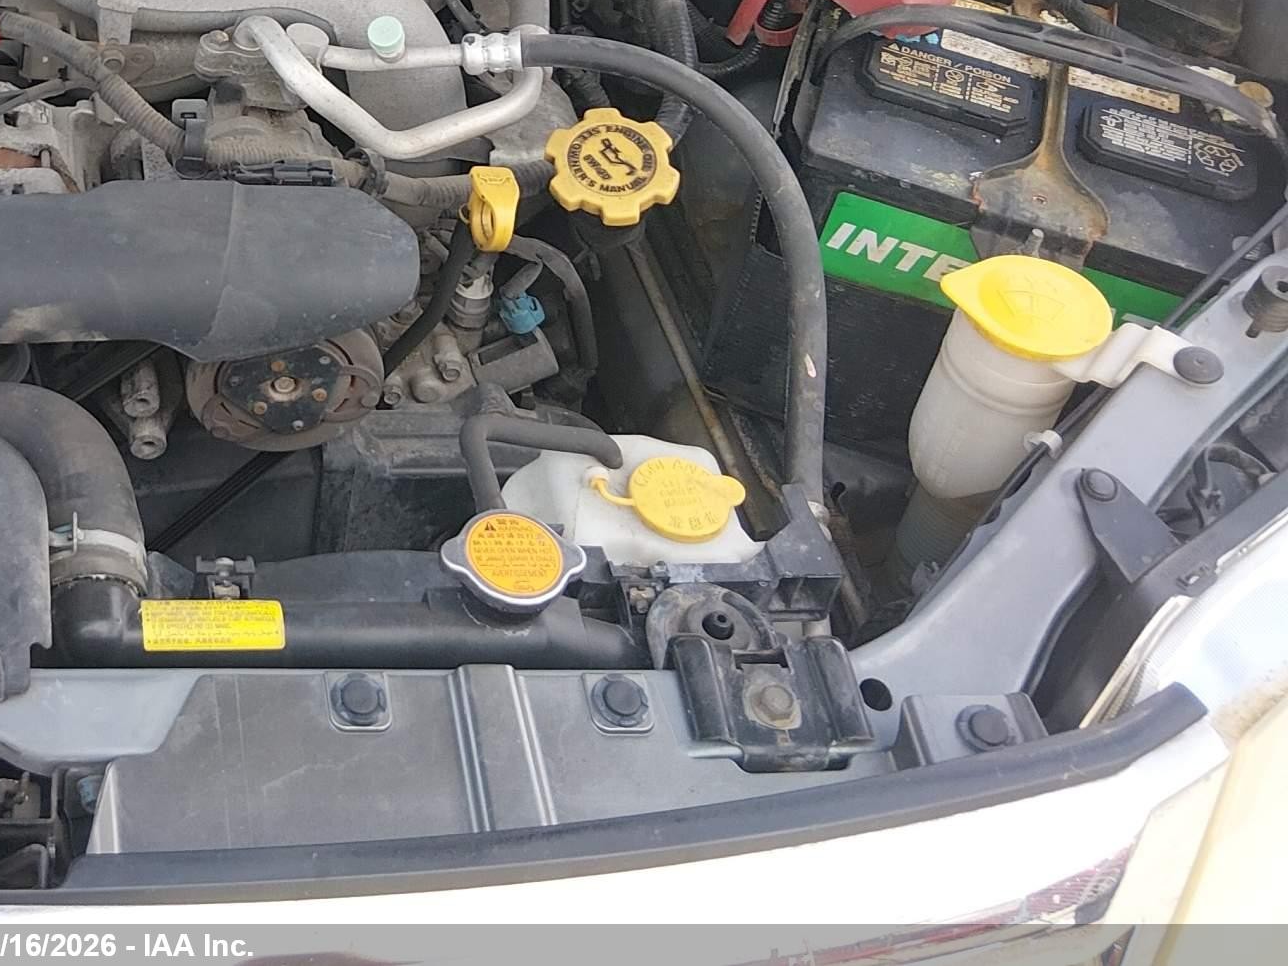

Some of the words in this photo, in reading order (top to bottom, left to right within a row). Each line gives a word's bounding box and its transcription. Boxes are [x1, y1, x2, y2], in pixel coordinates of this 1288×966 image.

[900, 46, 953, 67] DANGER
[964, 64, 1012, 84] POISON
[605, 125, 649, 154] ENGINE
[599, 175, 648, 193] MANUAL
